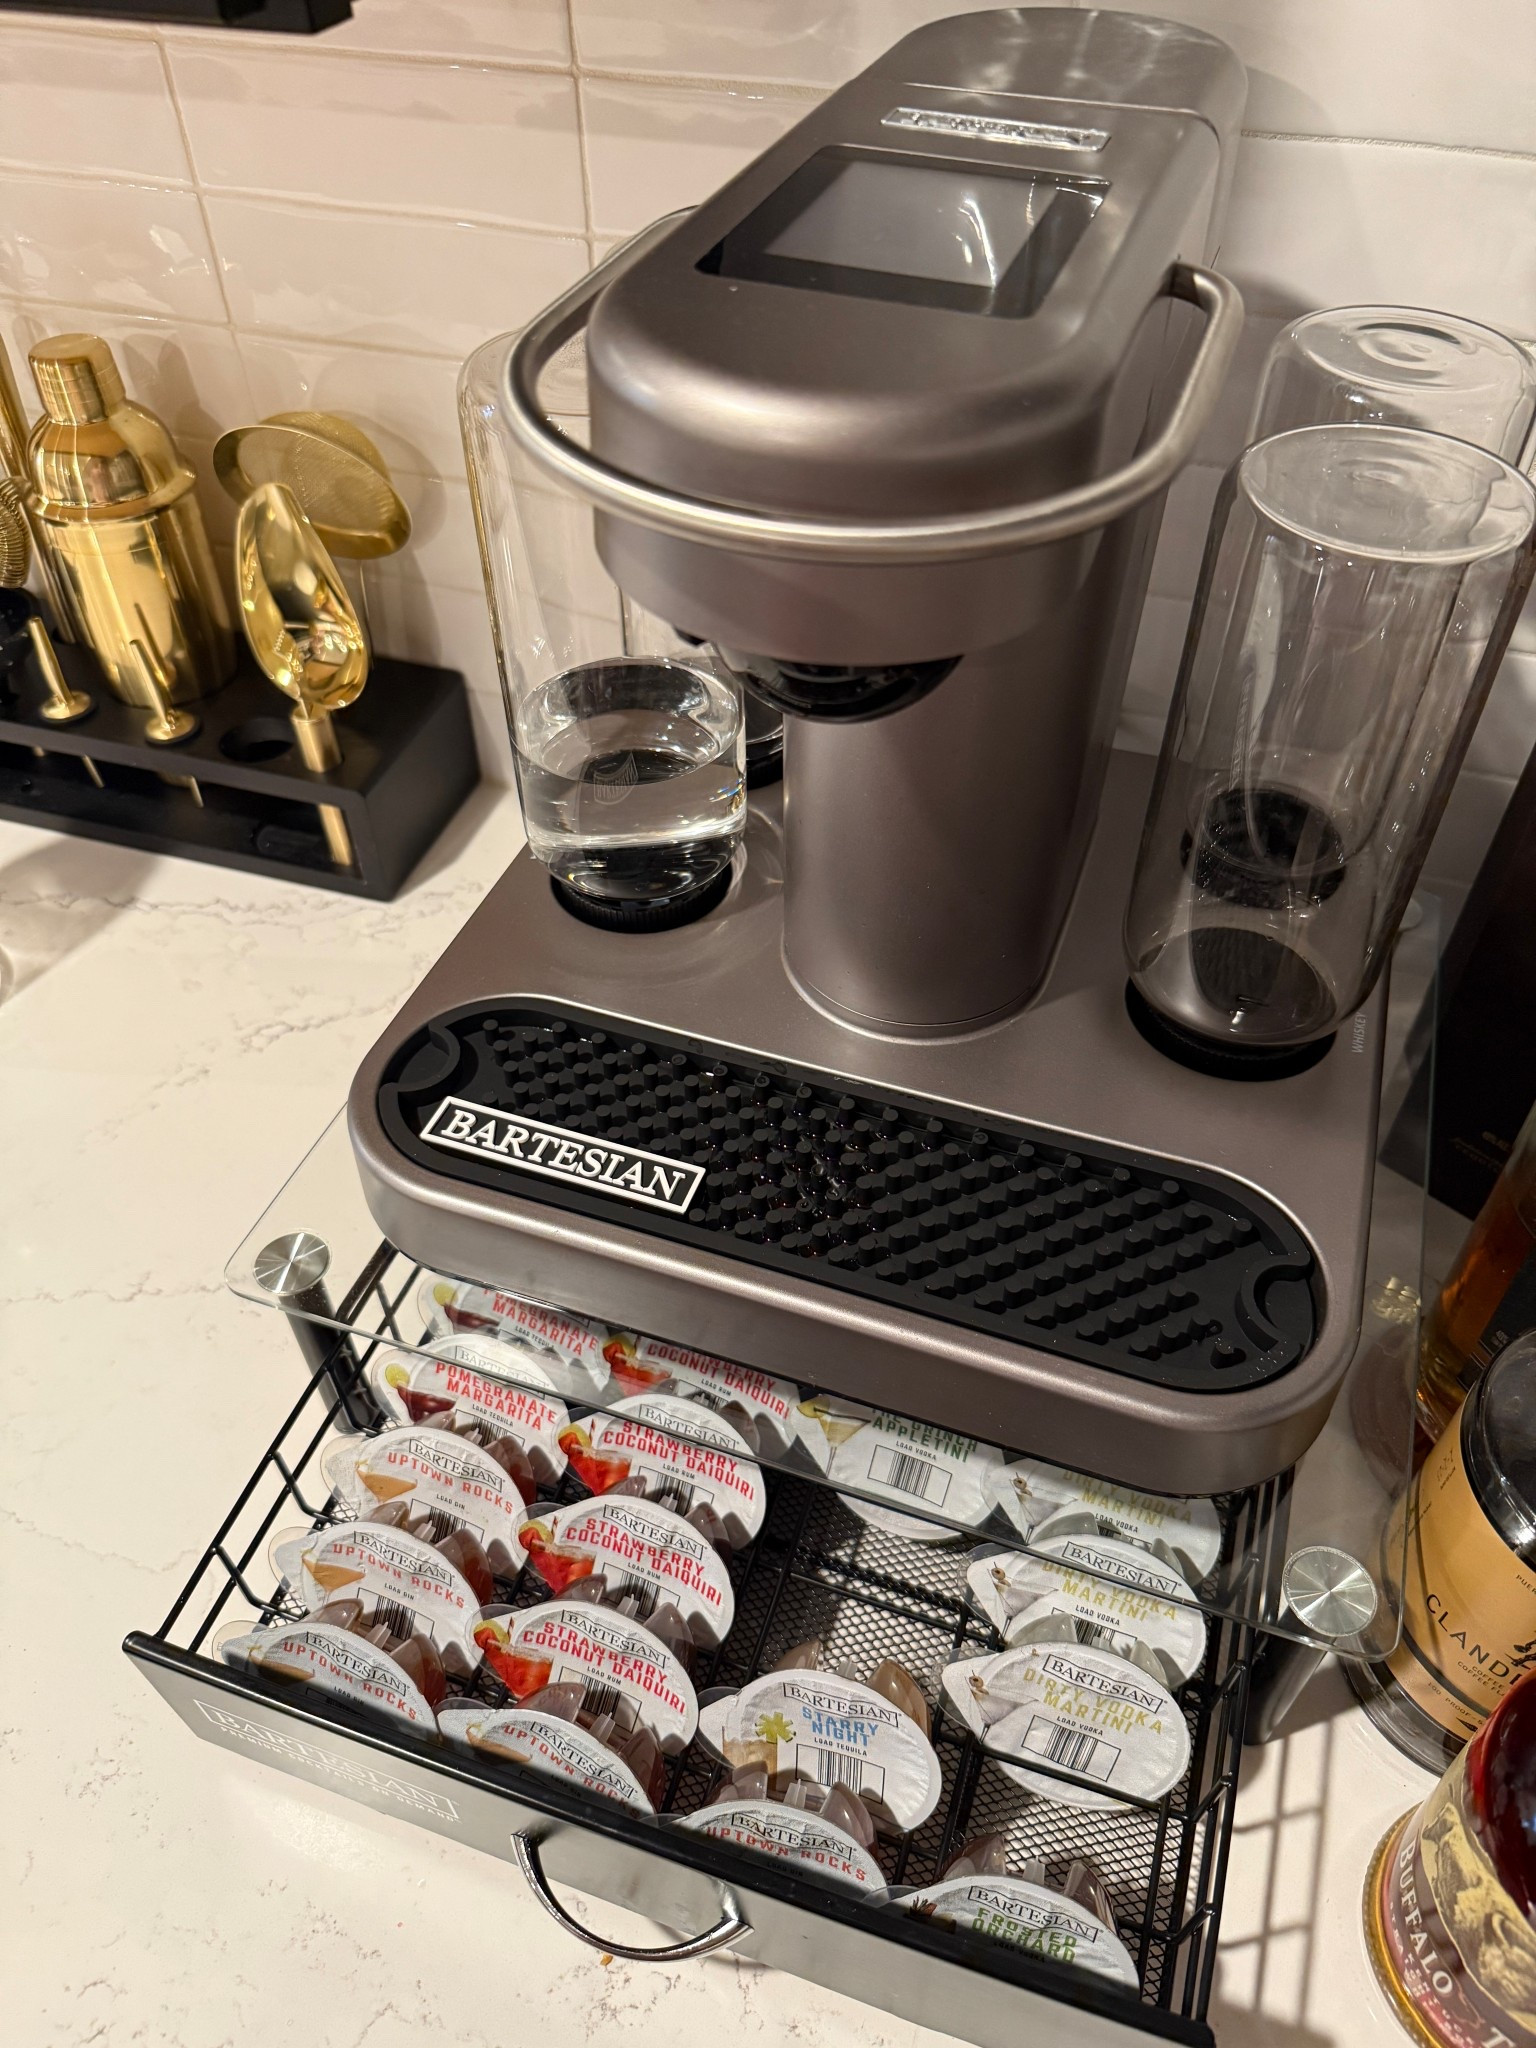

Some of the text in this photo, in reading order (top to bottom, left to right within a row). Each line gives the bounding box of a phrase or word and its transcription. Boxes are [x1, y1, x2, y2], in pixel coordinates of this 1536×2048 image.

[1352, 1012, 1365, 1053] WHISKEY
[441, 1109, 686, 1200] BARTESIAN
[492, 1299, 583, 1356] MARGARITA
[435, 1361, 557, 1424] POMEGRANATE
[647, 1342, 790, 1421] COCONUT DAIQUIRI
[701, 1378, 732, 1397] LOAD RUM
[446, 1378, 541, 1431] MARGARITA
[472, 1404, 514, 1427] LOAD TEQUILA
[622, 1420, 738, 1473] STRAWBERRY
[645, 1407, 731, 1449] BARTESIAN
[872, 1415, 969, 1463] APPLETINI
[896, 1441, 937, 1460] LOAD VODKA
[387, 1452, 513, 1515] UPTOWN ROCKS
[415, 1443, 498, 1487] BARTESIAN
[603, 1430, 755, 1501] COCONUT DAIQUIRI
[662, 1463, 696, 1480] LOAD RUM
[436, 1493, 466, 1510] LOAD GIN
[1082, 1488, 1164, 1528] MARTINI
[1095, 1513, 1139, 1533] LOAD VODKA
[1130, 1492, 1192, 1524] VODKA
[586, 1517, 706, 1577] STRAWBERRY
[610, 1508, 699, 1554] BARTESIAN
[333, 1543, 465, 1609] UPTOWN ROCKS
[360, 1535, 447, 1580] BARTESIAN
[566, 1527, 722, 1606] COCONUT DAIQUIRI
[627, 1562, 661, 1581] LOAD RUM
[1070, 1547, 1170, 1592] BARTESIAN
[384, 1583, 415, 1600] LOAD GIN
[1062, 1578, 1148, 1622] MARTINI
[1112, 1585, 1177, 1621] VODKA
[1075, 1604, 1120, 1626] LOAD VODKA
[544, 1621, 668, 1684] STRAWBERRY
[567, 1614, 662, 1662] BARTESIAN
[283, 1641, 417, 1721] UPTOWN ROCKS
[311, 1635, 402, 1690] BARTESIAN
[523, 1630, 686, 1715] COCONUT DAIQUIRI
[587, 1666, 622, 1686] LOAD RUM
[1050, 1659, 1158, 1707] BARTESIAN
[1457, 1661, 1488, 1687] COFFEE
[791, 1687, 892, 1722] BARTESIAN
[802, 1706, 879, 1736] STARRY
[1023, 1667, 1163, 1735] DIRTY VODKA
[1043, 1690, 1134, 1735] MARTINI
[1445, 1697, 1471, 1716] PROOF
[220, 1726, 282, 1754] PREMIUM
[812, 1721, 870, 1747] NIGHT
[814, 1737, 868, 1757] LOAD TEQUILA
[1056, 1715, 1104, 1736] LOAD VODKA
[212, 1709, 438, 1807] BARTESIAN
[503, 1724, 575, 1776] UPTOWN
[538, 1725, 629, 1791] BARTESIAN
[706, 1826, 867, 1882] UPTOWN ROCKS
[739, 1817, 848, 1855] BARTESIAN
[976, 1889, 1090, 1936] BARTESIAN
[977, 1907, 1078, 1947] FROSTED
[1399, 1838, 1454, 1995] BUFFALO
[972, 1918, 1076, 1964] ORCHARD
